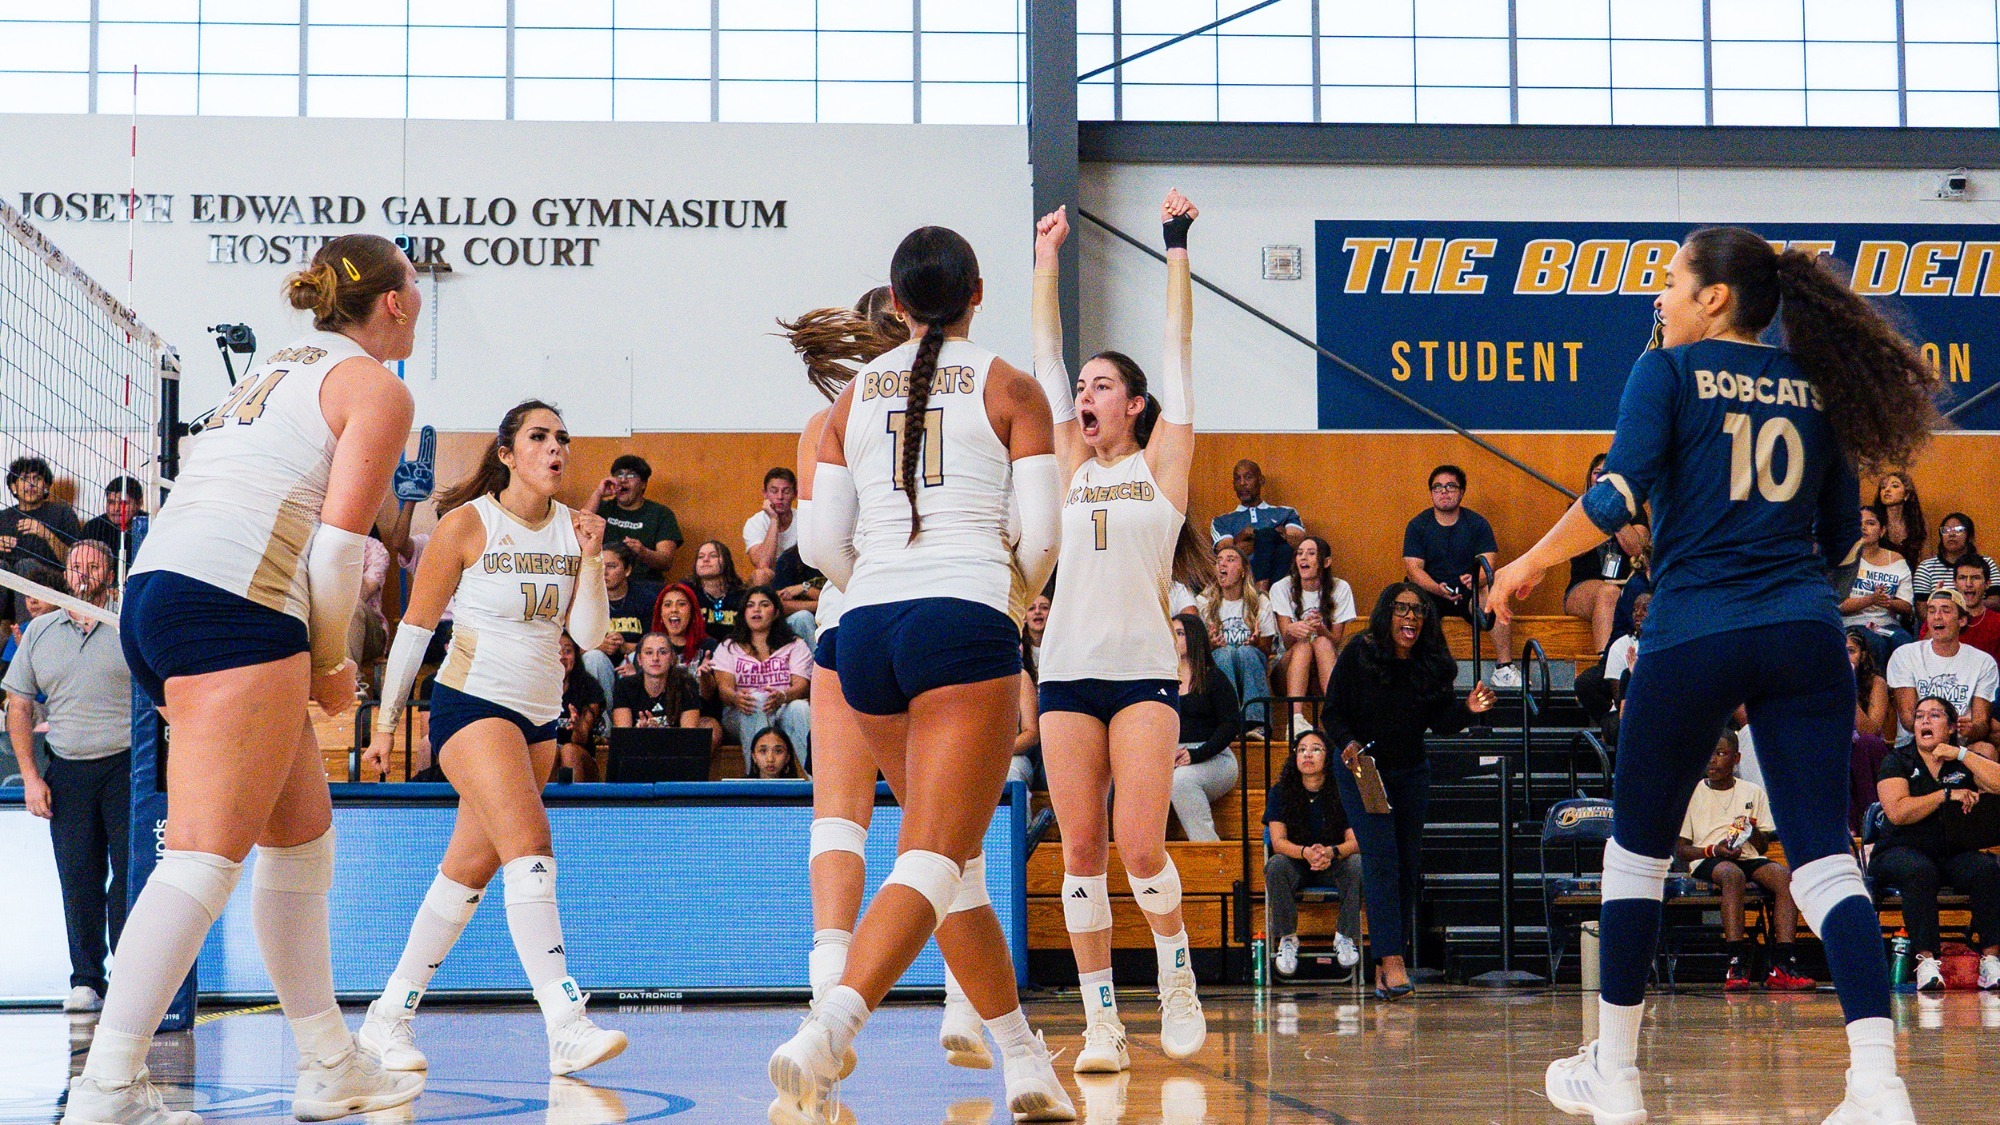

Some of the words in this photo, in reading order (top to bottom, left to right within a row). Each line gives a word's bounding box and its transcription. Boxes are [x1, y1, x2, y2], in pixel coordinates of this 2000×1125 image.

[19, 192, 174, 223] JOSEPH
[190, 193, 366, 225] EDWARD
[381, 196, 517, 226] GALLO
[532, 197, 788, 229] GYMNASIUM
[464, 237, 600, 267] COURT
[1342, 237, 1498, 294] THE
[1391, 341, 1583, 382] STUDENT
[205, 369, 290, 431] 24
[862, 365, 975, 402] BOBATS
[886, 407, 944, 491] 11
[1722, 412, 1804, 502] 10
[1081, 480, 1155, 504] MERCED
[1091, 508, 1108, 551] 1
[484, 552, 513, 575] UC
[1866, 570, 1900, 584] MERCED
[520, 582, 560, 621] 14
[737, 671, 790, 685] ATHLETICS
